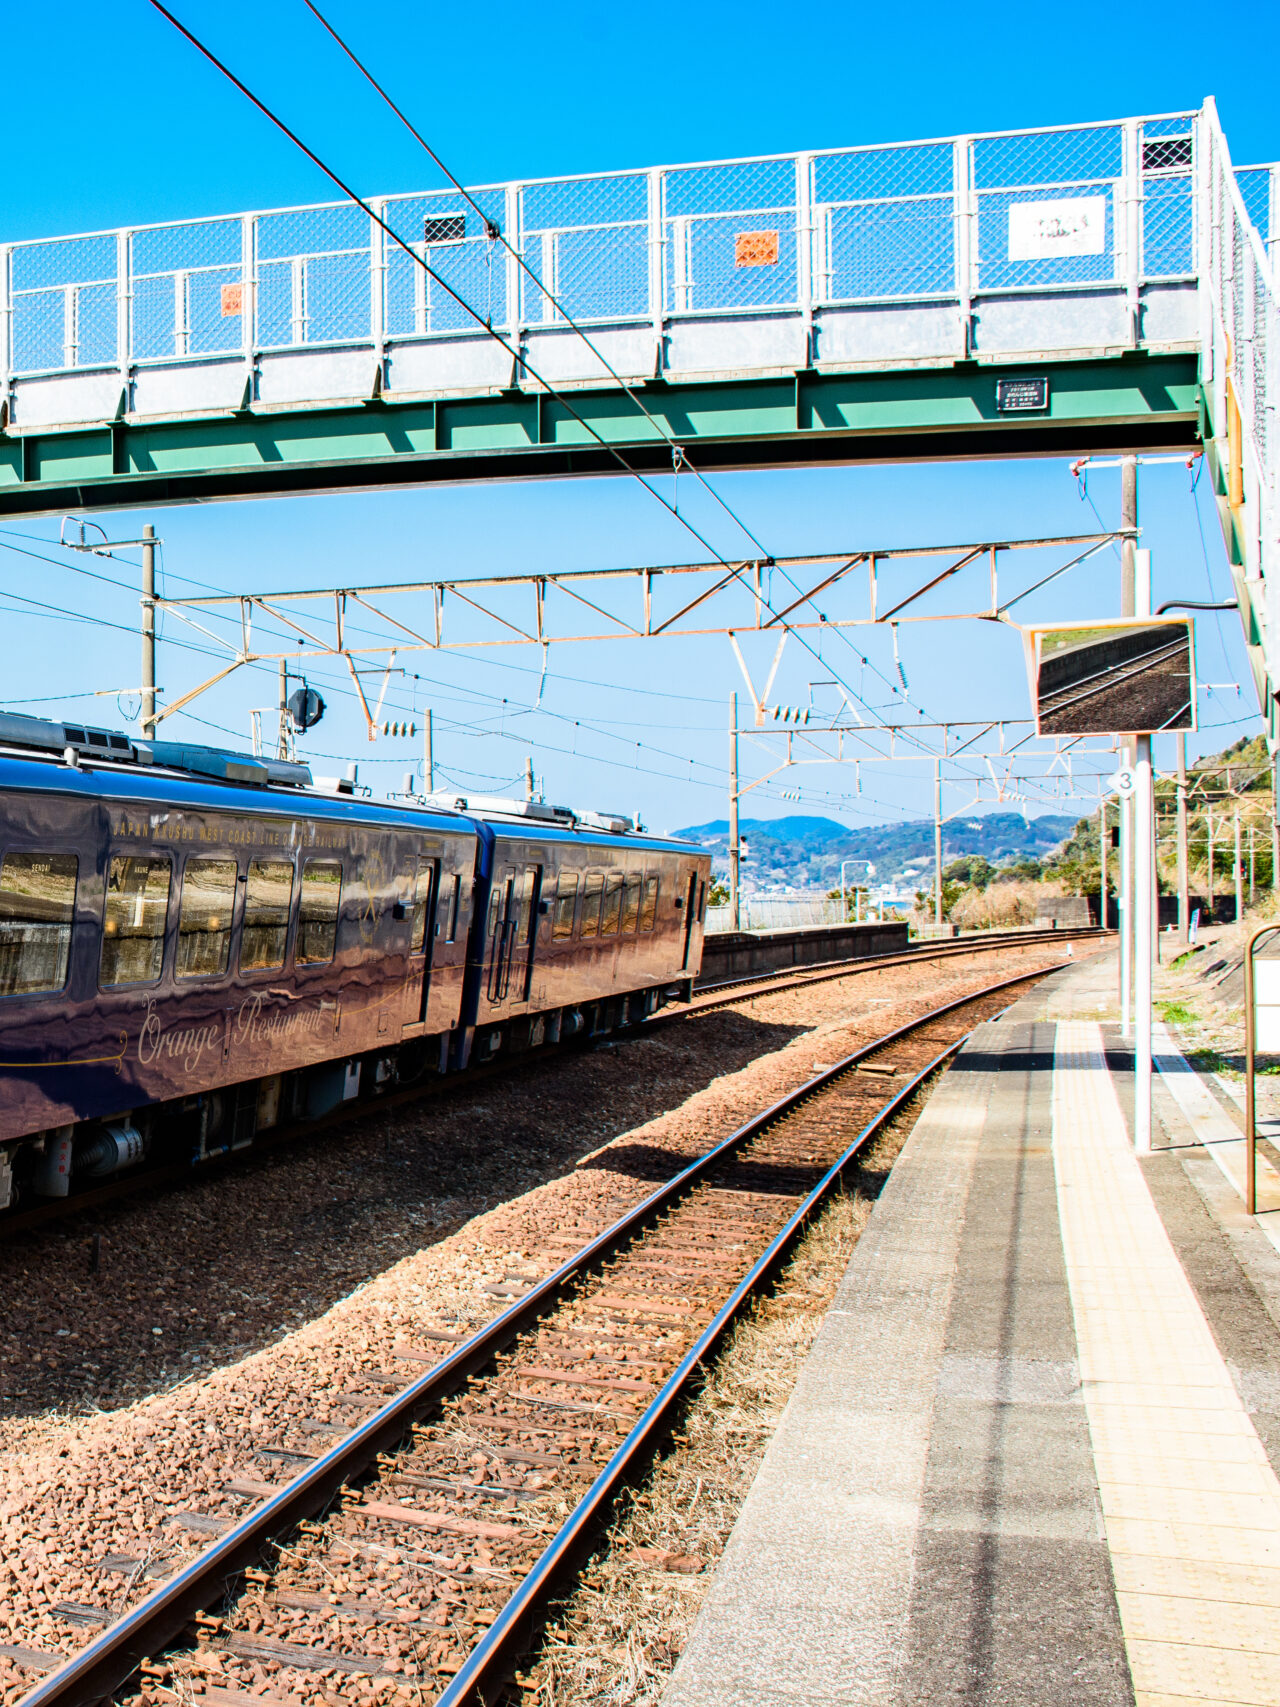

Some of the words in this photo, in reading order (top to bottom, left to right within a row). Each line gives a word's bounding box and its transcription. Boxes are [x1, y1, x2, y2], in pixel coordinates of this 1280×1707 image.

[1119, 772, 1133, 790] 3
[113, 821, 149, 837] JAPAN
[200, 827, 225, 841] WEST
[228, 829, 257, 844] COAST
[259, 831, 280, 845] LINE
[138, 993, 225, 1073] Orange
[233, 990, 322, 1047] Restaurant
